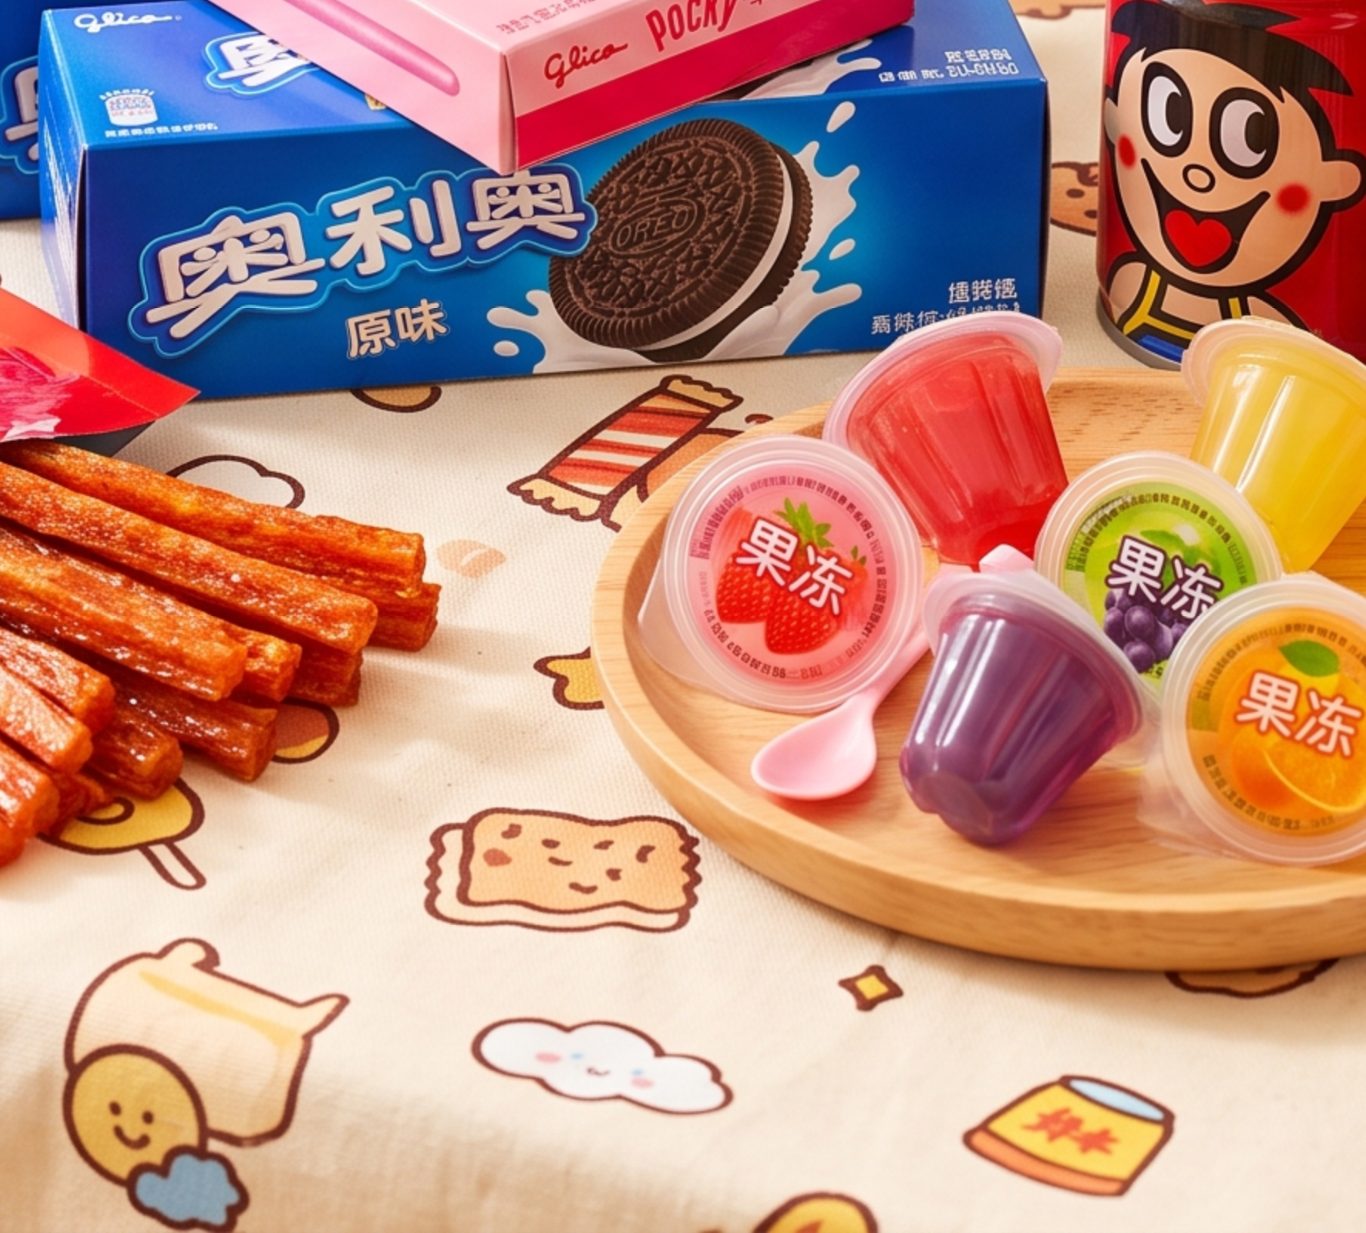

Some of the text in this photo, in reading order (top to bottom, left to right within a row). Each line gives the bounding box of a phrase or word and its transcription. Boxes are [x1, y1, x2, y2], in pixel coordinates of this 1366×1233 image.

[73, 11, 173, 34] Glico
[544, 38, 628, 89] Glico
[146, 169, 586, 340] 奥利奥
[344, 297, 450, 361] 原味
[734, 518, 854, 617] 果冻
[1106, 536, 1223, 620] 果冻
[1235, 671, 1364, 758] 果冻
